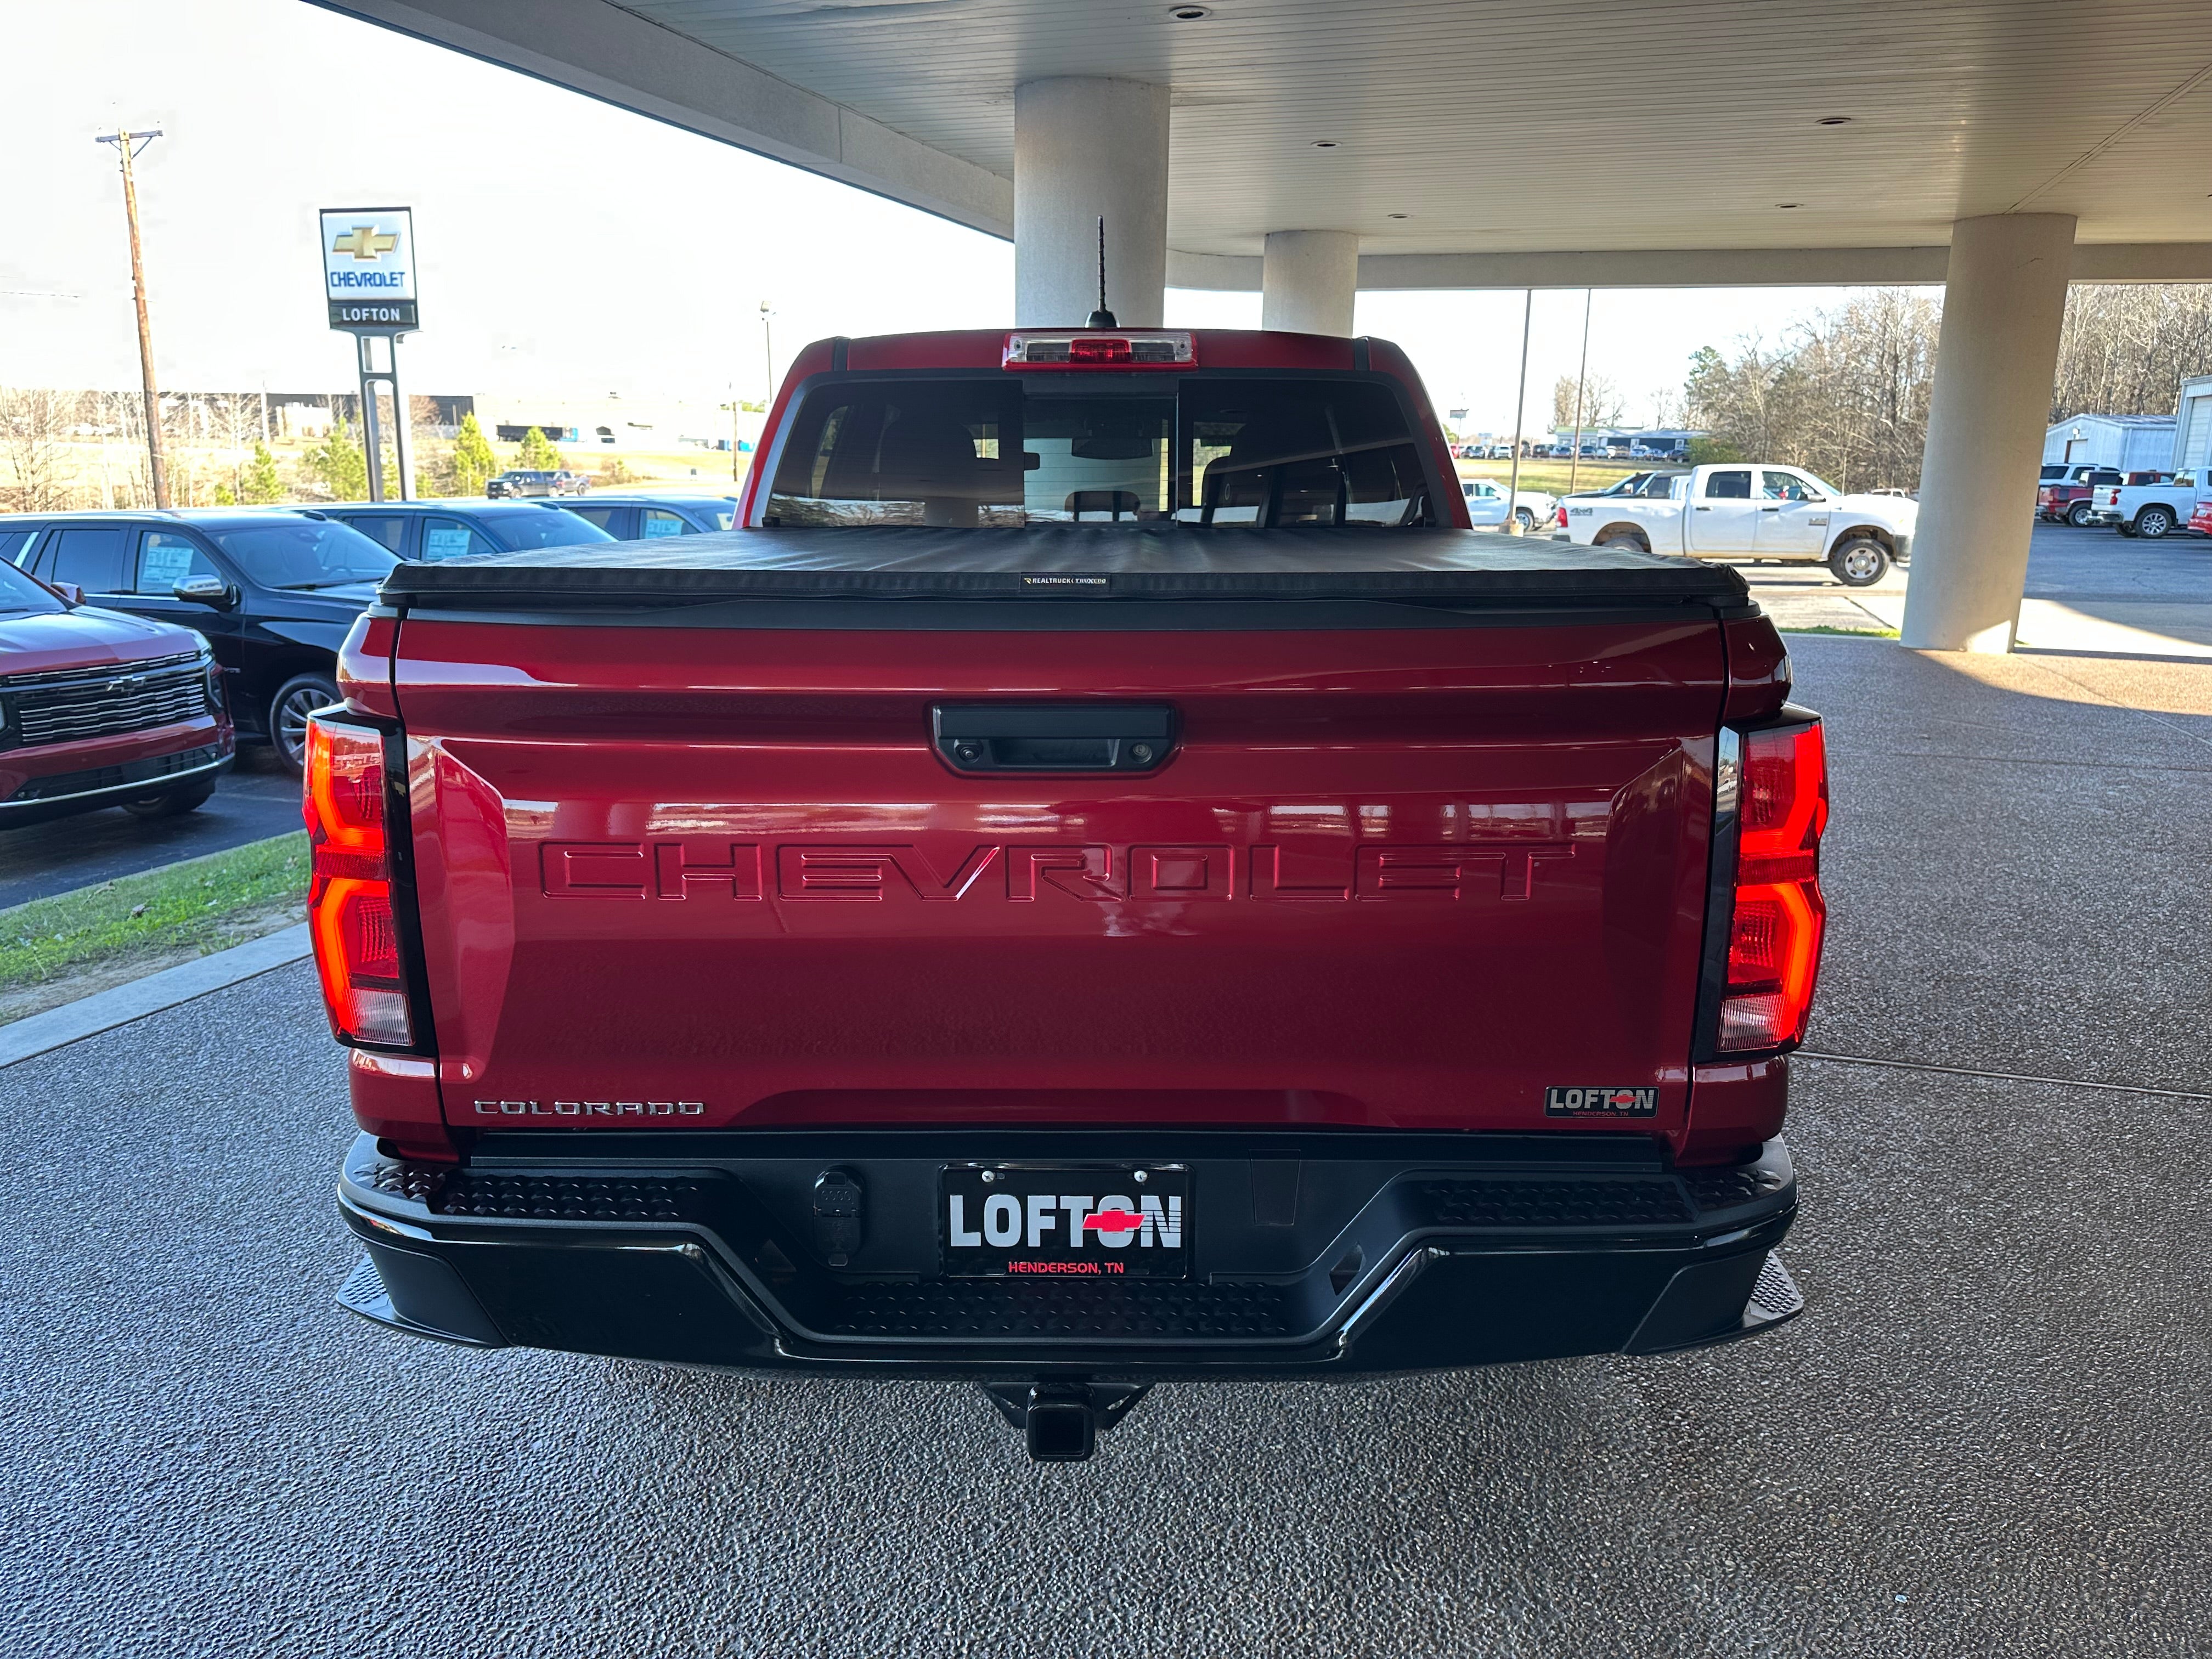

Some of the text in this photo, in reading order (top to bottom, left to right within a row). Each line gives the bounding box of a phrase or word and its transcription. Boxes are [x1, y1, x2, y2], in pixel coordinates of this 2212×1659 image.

[330, 272, 405, 287] CHEVROLET
[342, 308, 400, 321] LOFTON
[539, 841, 1576, 902] CHEVROLET
[473, 1099, 706, 1116] COLORADO
[1550, 1088, 1655, 1110] LOFTON
[950, 1194, 1182, 1248] LOFTON
[1008, 1261, 1125, 1275] HENDERSON, TN
